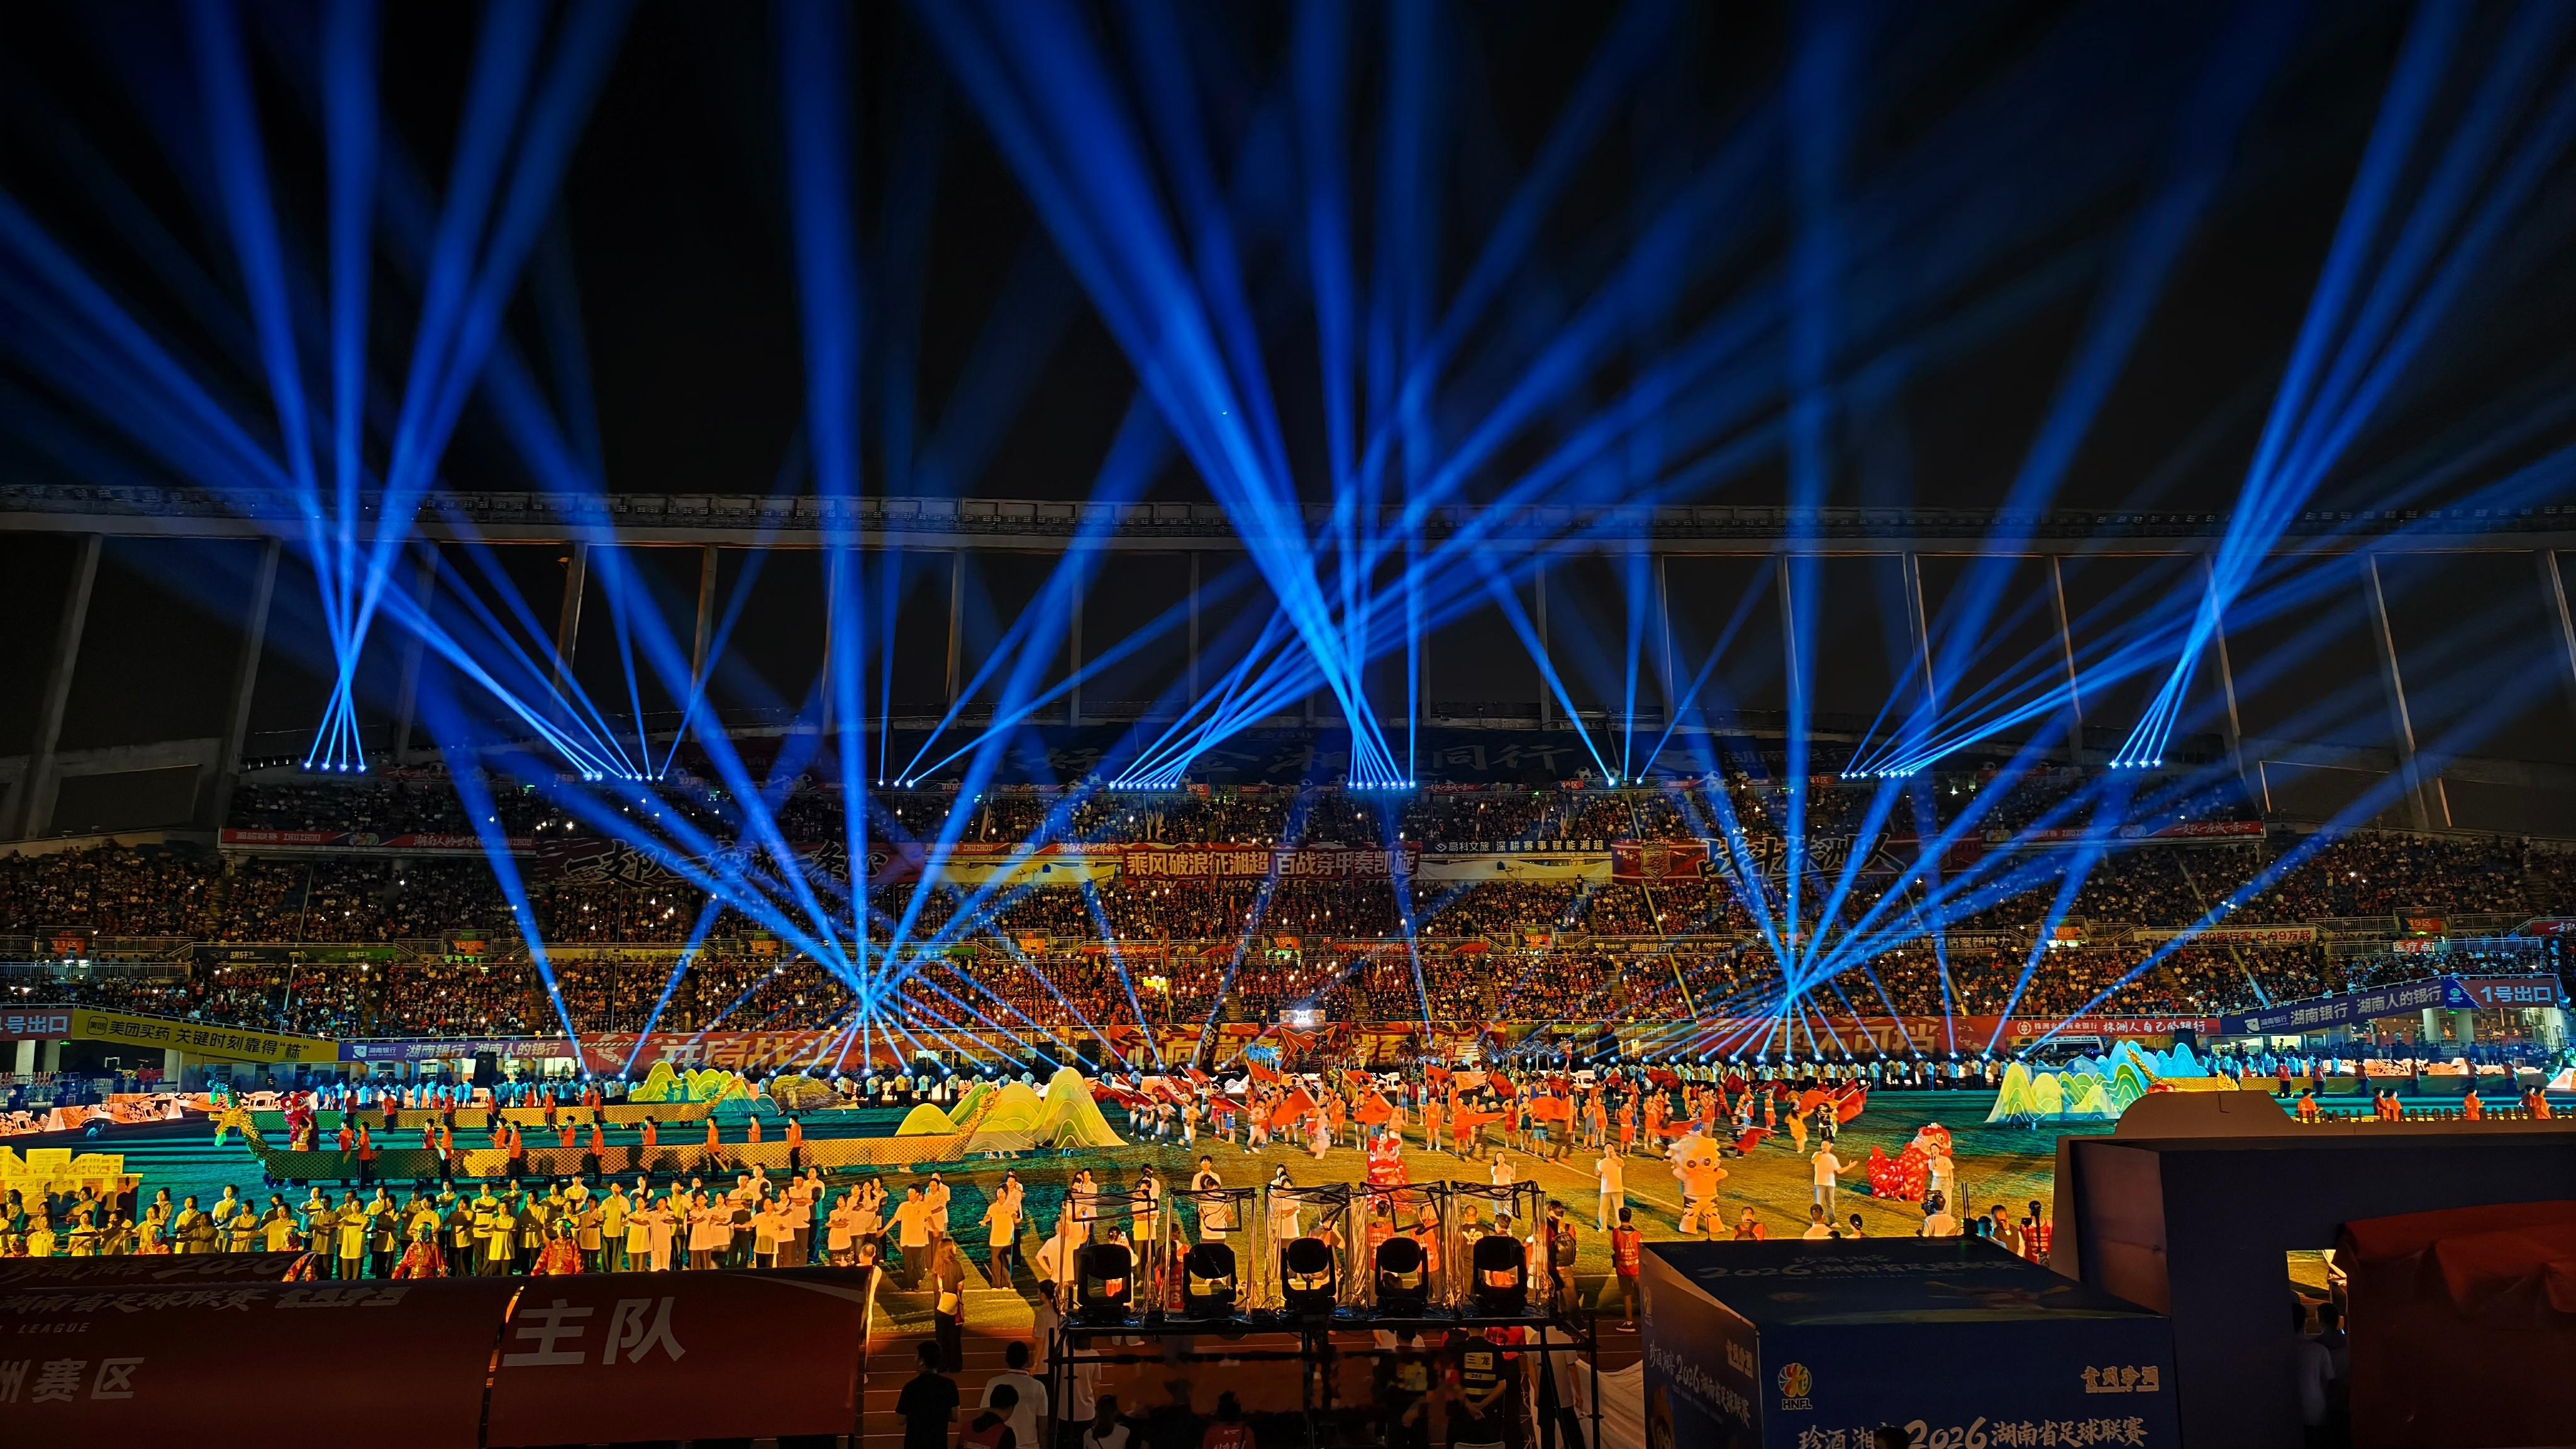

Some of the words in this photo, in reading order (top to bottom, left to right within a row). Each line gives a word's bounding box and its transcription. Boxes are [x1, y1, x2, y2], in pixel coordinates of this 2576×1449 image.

[1448, 841, 1489, 852] 高科文旅
[1496, 840, 1605, 852] 深耕赛事赋能湘超
[1127, 851, 1269, 875] 乘风破浪征湘超
[1277, 851, 1415, 875] 百战穿甲奏凯旋
[2480, 986, 2552, 1002] 1号出口
[2290, 1002, 2348, 1026] 湖南银行
[2357, 985, 2442, 1015] 湖南人的银行
[0, 1014, 68, 1034] 号出口
[110, 1021, 171, 1041] 美团买药
[175, 1028, 309, 1059] 关键时刻靠得“株”
[405, 1044, 466, 1058] 湖南银行
[474, 1042, 560, 1057] 湖南人的银行
[17, 1323, 91, 1334] LEAGUE
[502, 1296, 687, 1367] 主队
[1781, 1397, 1813, 1411] HNFL
[1797, 1421, 1896, 1449] 珍酒湘
